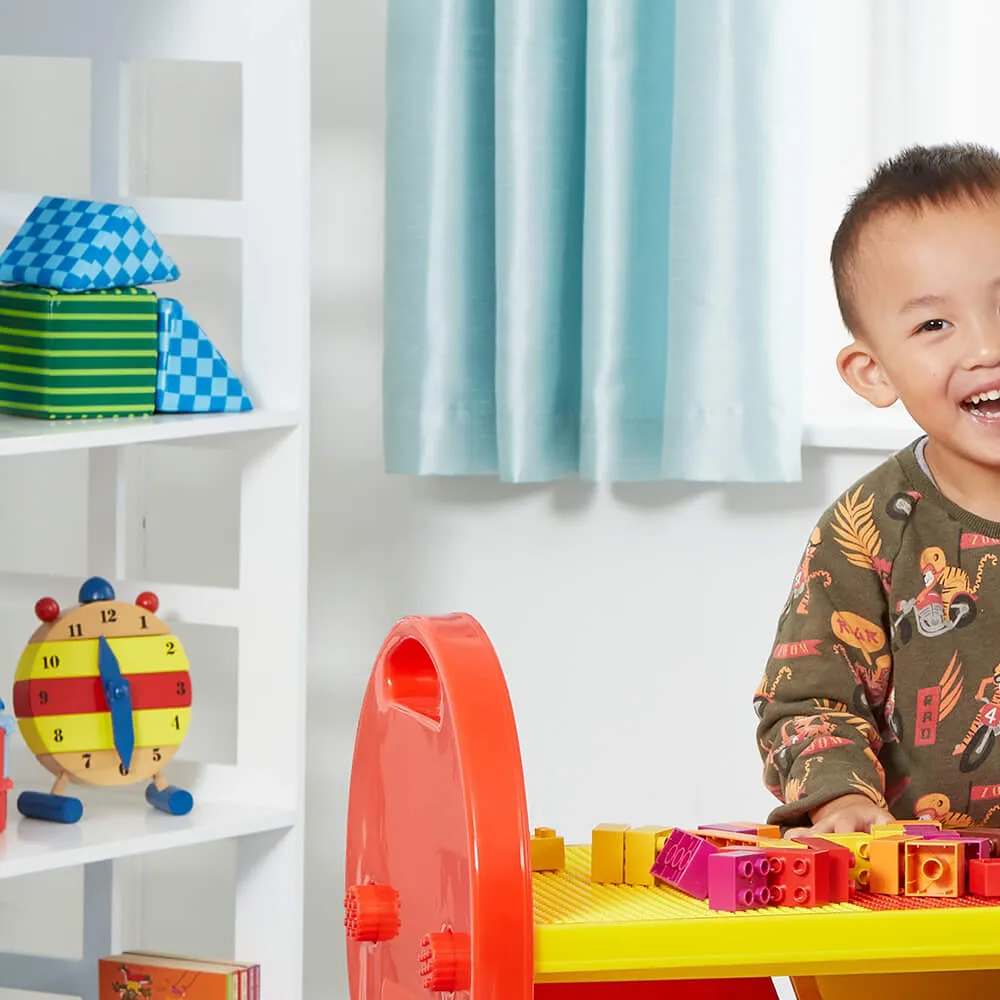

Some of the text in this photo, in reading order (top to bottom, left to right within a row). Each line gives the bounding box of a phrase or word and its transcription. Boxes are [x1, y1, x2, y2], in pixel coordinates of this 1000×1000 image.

[101, 608, 117, 623] 12
[139, 615, 148, 629] 1
[68, 624, 83, 637] 11
[166, 641, 175, 655] 2
[42, 655, 60, 669] 10
[176, 681, 186, 695] 3
[38, 691, 48, 705] 9
[985, 706, 997, 724] 4
[171, 715, 180, 730] 4
[53, 728, 64, 742] 8
[82, 753, 91, 769] 7
[152, 747, 162, 762] 5
